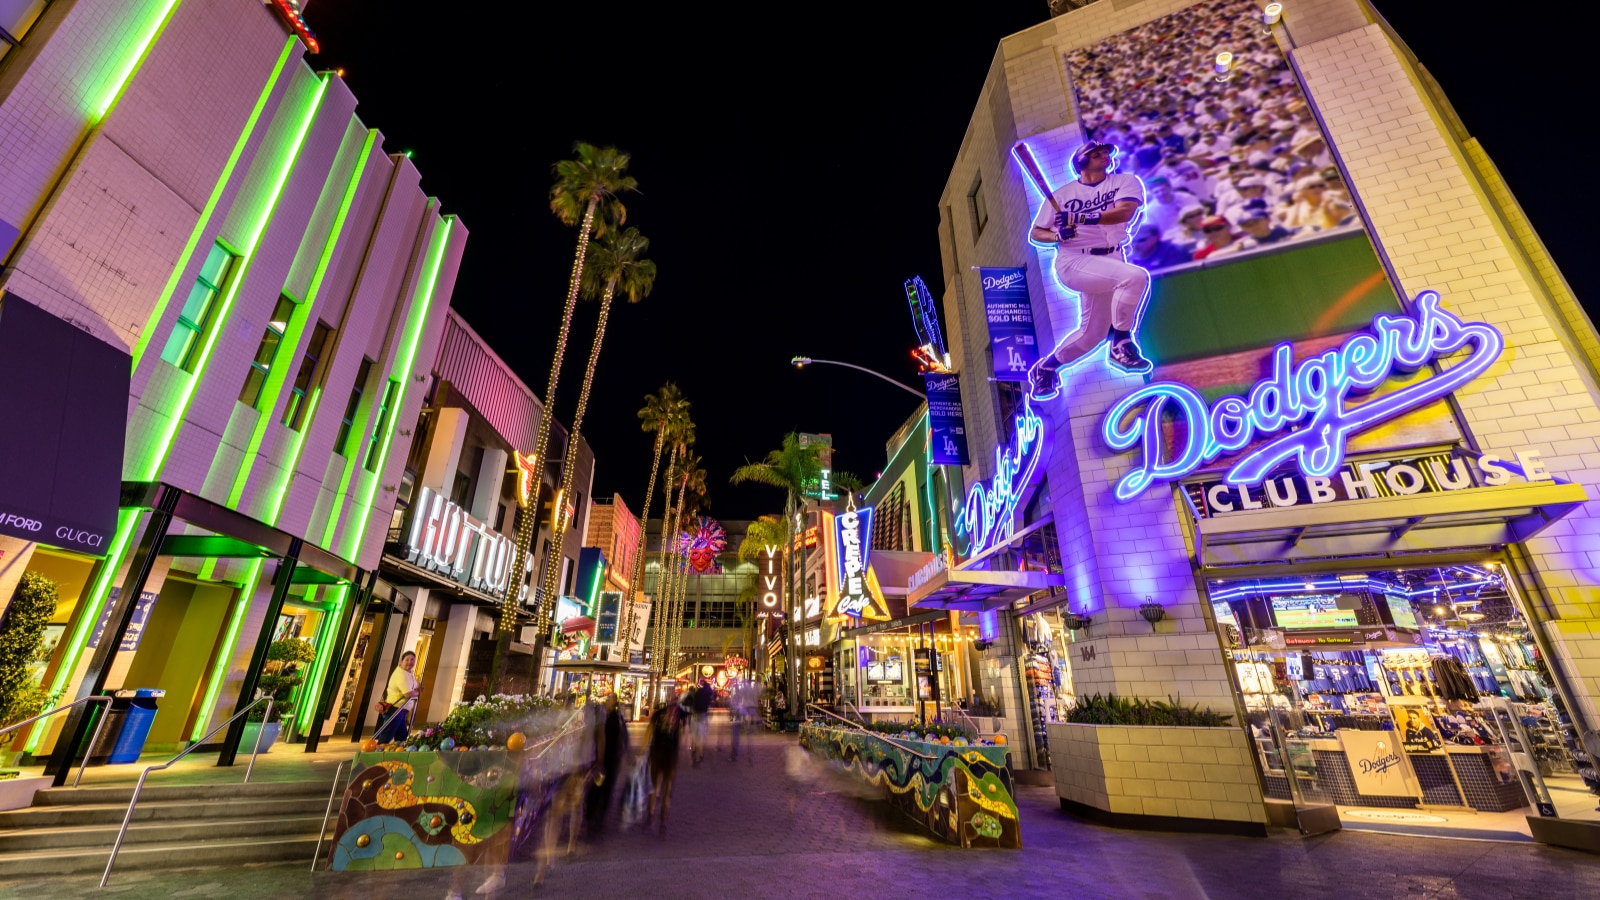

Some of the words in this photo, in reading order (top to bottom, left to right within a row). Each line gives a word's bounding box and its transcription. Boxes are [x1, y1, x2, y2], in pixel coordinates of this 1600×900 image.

[983, 270, 1025, 290] Dodgers
[988, 315, 1010, 323] SOLD
[1012, 315, 1033, 323] HERE
[1006, 346, 1027, 372] LA
[926, 376, 958, 391] Dodgers
[1101, 289, 1504, 500] Dodgers
[943, 435, 958, 456] LA
[965, 393, 1044, 558] Dodgers
[1208, 450, 1552, 512] CLUBHOUSE
[4, 514, 43, 532] FORD
[55, 526, 103, 548] GUCCI
[409, 486, 478, 574] HOT
[841, 511, 863, 595] CREPE
[763, 544, 777, 607] VIVO
[1081, 645, 1096, 662] 164
[1358, 751, 1401, 775] Dodgers
